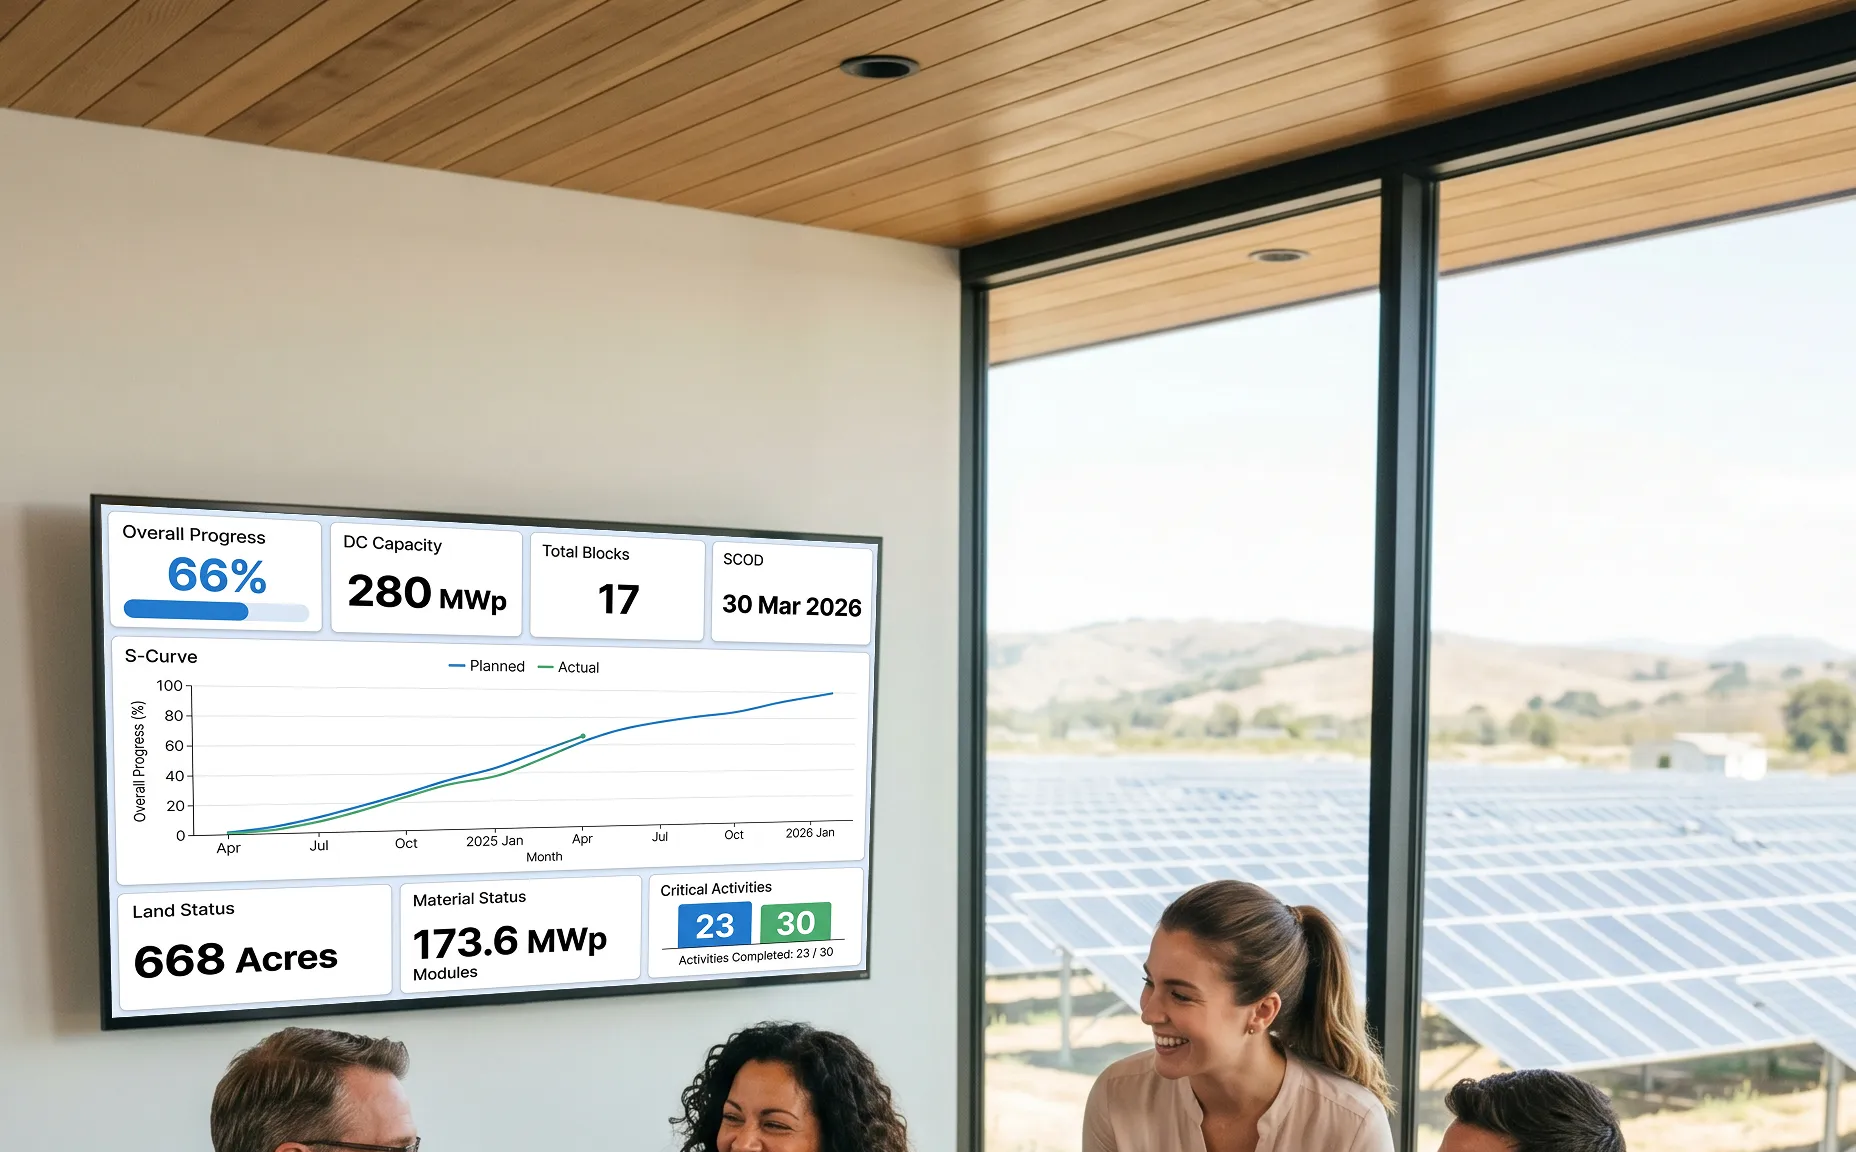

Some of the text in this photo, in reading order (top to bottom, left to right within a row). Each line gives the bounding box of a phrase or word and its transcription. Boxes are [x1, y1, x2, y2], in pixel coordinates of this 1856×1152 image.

[123, 525, 265, 546] Overall Progress
[344, 535, 442, 555] DC Capacity
[542, 544, 629, 560] Total Blocks
[724, 553, 763, 566] SCOD
[169, 557, 266, 594] 66%
[349, 574, 506, 615] 280 MWp
[599, 584, 639, 614] 17
[723, 594, 861, 617] 30 Mar 2026
[126, 649, 197, 663] S-Curve
[471, 660, 599, 673] Planned Actual
[157, 680, 182, 691] 100
[165, 710, 183, 721] 80
[166, 740, 183, 751] 60
[131, 701, 147, 822] Overall Progress (%)
[166, 770, 184, 781] 40
[167, 800, 184, 811] 20
[177, 830, 185, 841] 0
[572, 834, 593, 846] Apr
[652, 832, 668, 841] Jul
[725, 830, 744, 839] Oct
[786, 828, 834, 838] 2026 Jan
[310, 840, 328, 851] Jul
[395, 838, 417, 848] Oct
[467, 836, 523, 846] 2025 Jan
[217, 843, 241, 856] Apr
[527, 852, 562, 862] Month
[661, 881, 772, 896] Critical Activities
[414, 892, 526, 906] Material Status
[133, 903, 234, 918] Land Status
[697, 913, 733, 938] 23
[777, 911, 815, 935] 30
[414, 926, 607, 959] 173.6 MWp
[135, 943, 337, 978] 668 Acres
[679, 947, 833, 965] Activities Completed: 23 / 30
[414, 967, 477, 981] Modules
